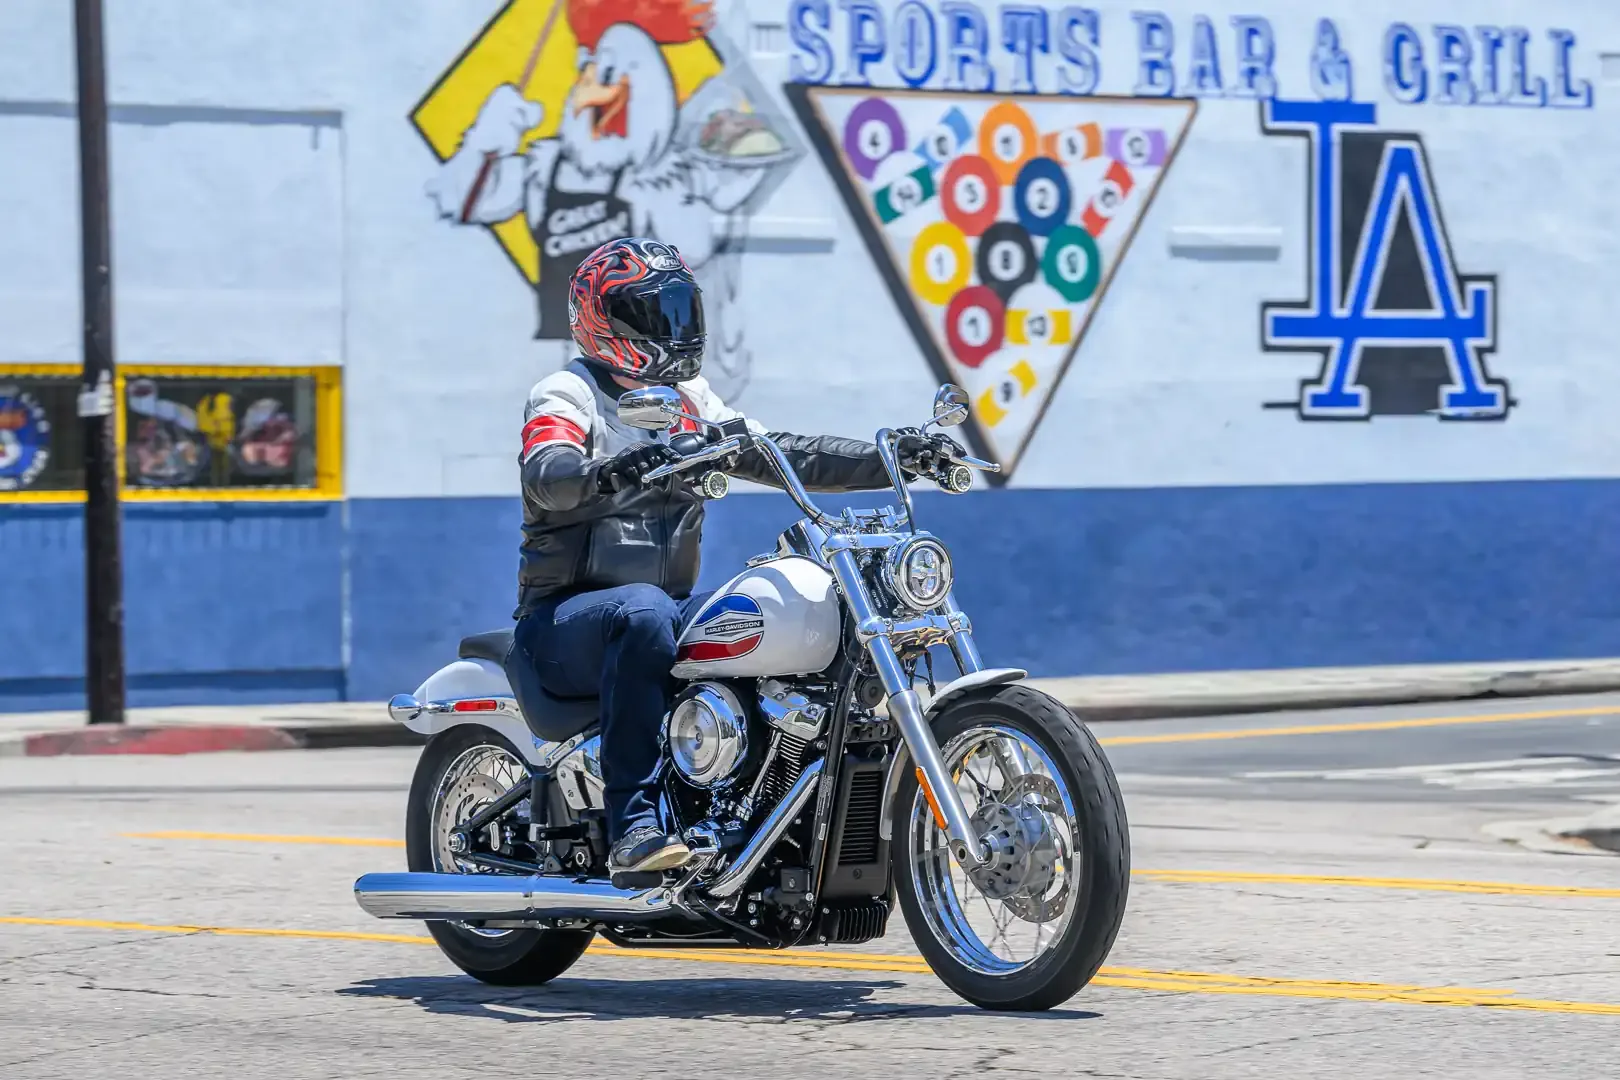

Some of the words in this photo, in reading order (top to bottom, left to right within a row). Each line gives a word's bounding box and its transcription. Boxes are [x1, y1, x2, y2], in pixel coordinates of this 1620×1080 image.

[786, 0, 1101, 95] SPORTS
[1131, 11, 1278, 99] BAR
[1310, 18, 1354, 101] &
[1383, 22, 1594, 108] GRILL
[867, 130, 882, 155] 4
[1036, 186, 1049, 211] 2
[1261, 99, 1511, 421] LA
[705, 620, 761, 634] HARLEY-DAVIDSON
